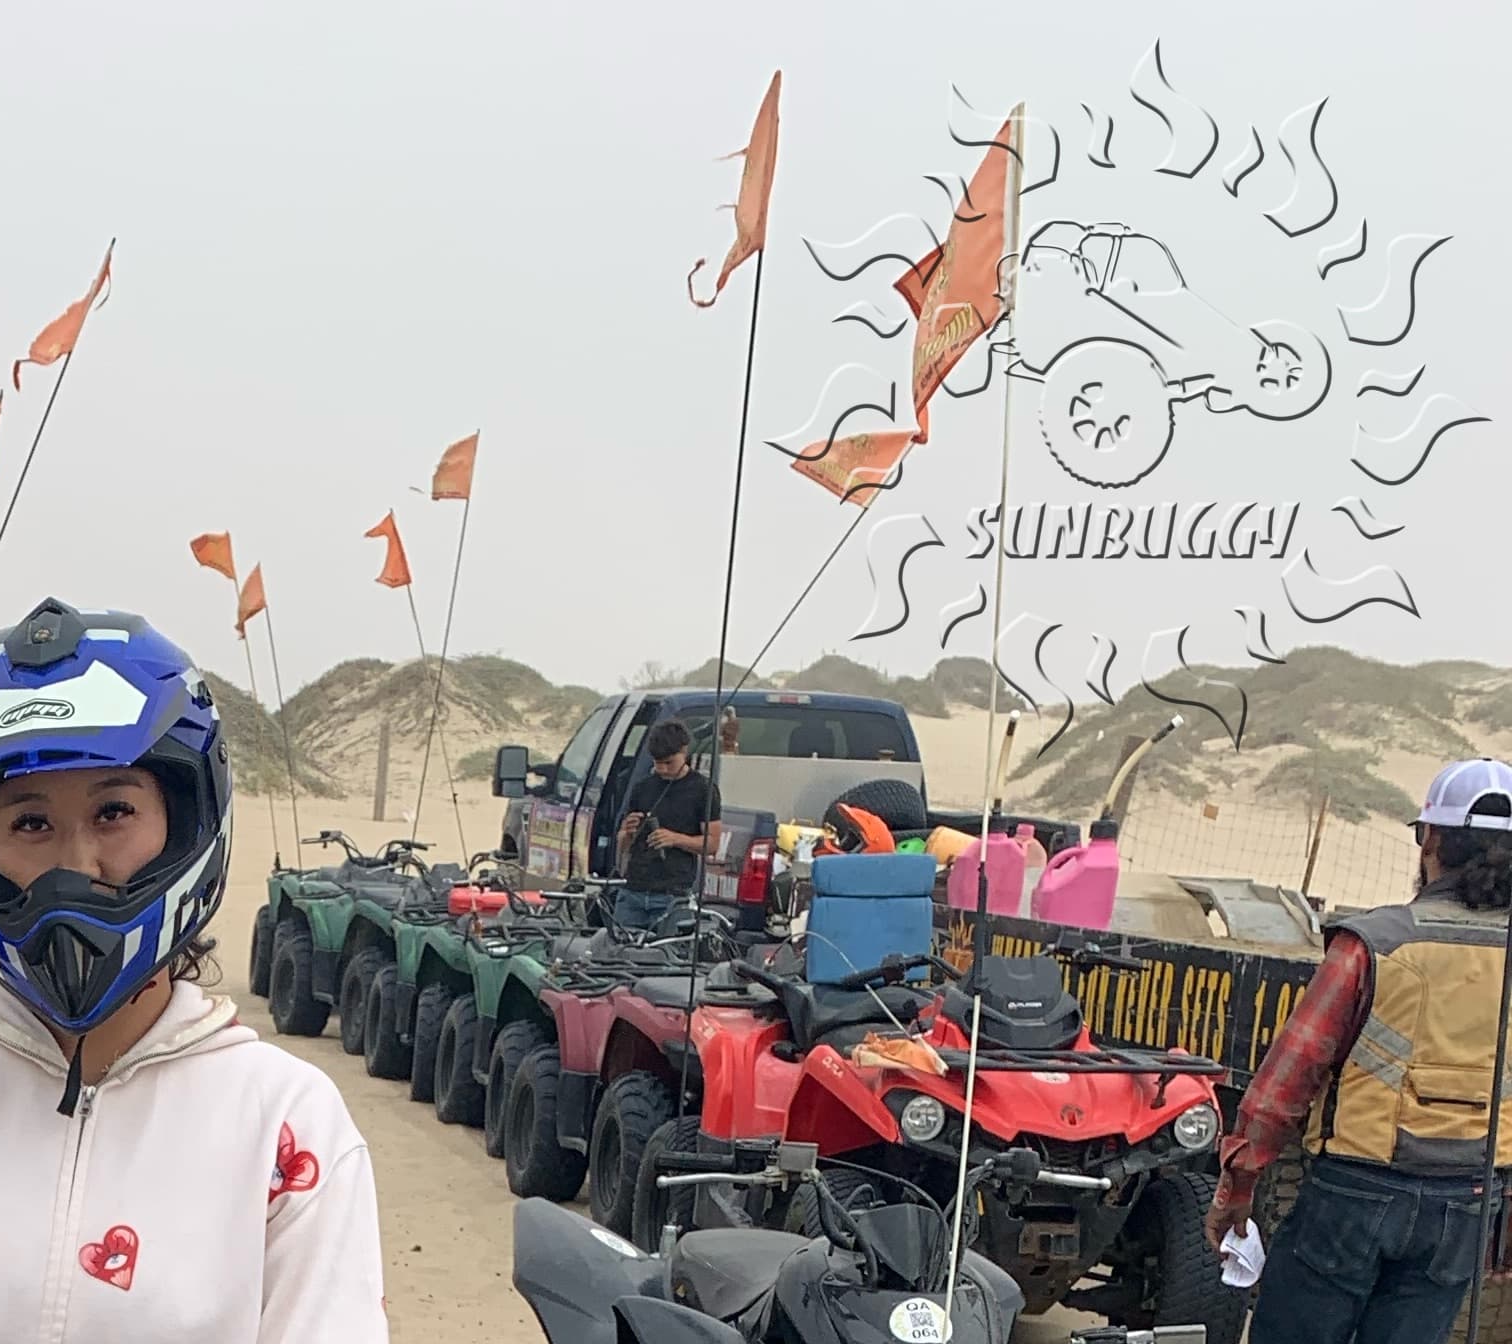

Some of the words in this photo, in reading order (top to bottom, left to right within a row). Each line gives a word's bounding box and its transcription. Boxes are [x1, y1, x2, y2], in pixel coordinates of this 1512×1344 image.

[1112, 958, 1174, 1048] NEVER
[1177, 965, 1233, 1064] SETS
[1249, 979, 1306, 1073] 1-8
[912, 1328, 939, 1339] 064
